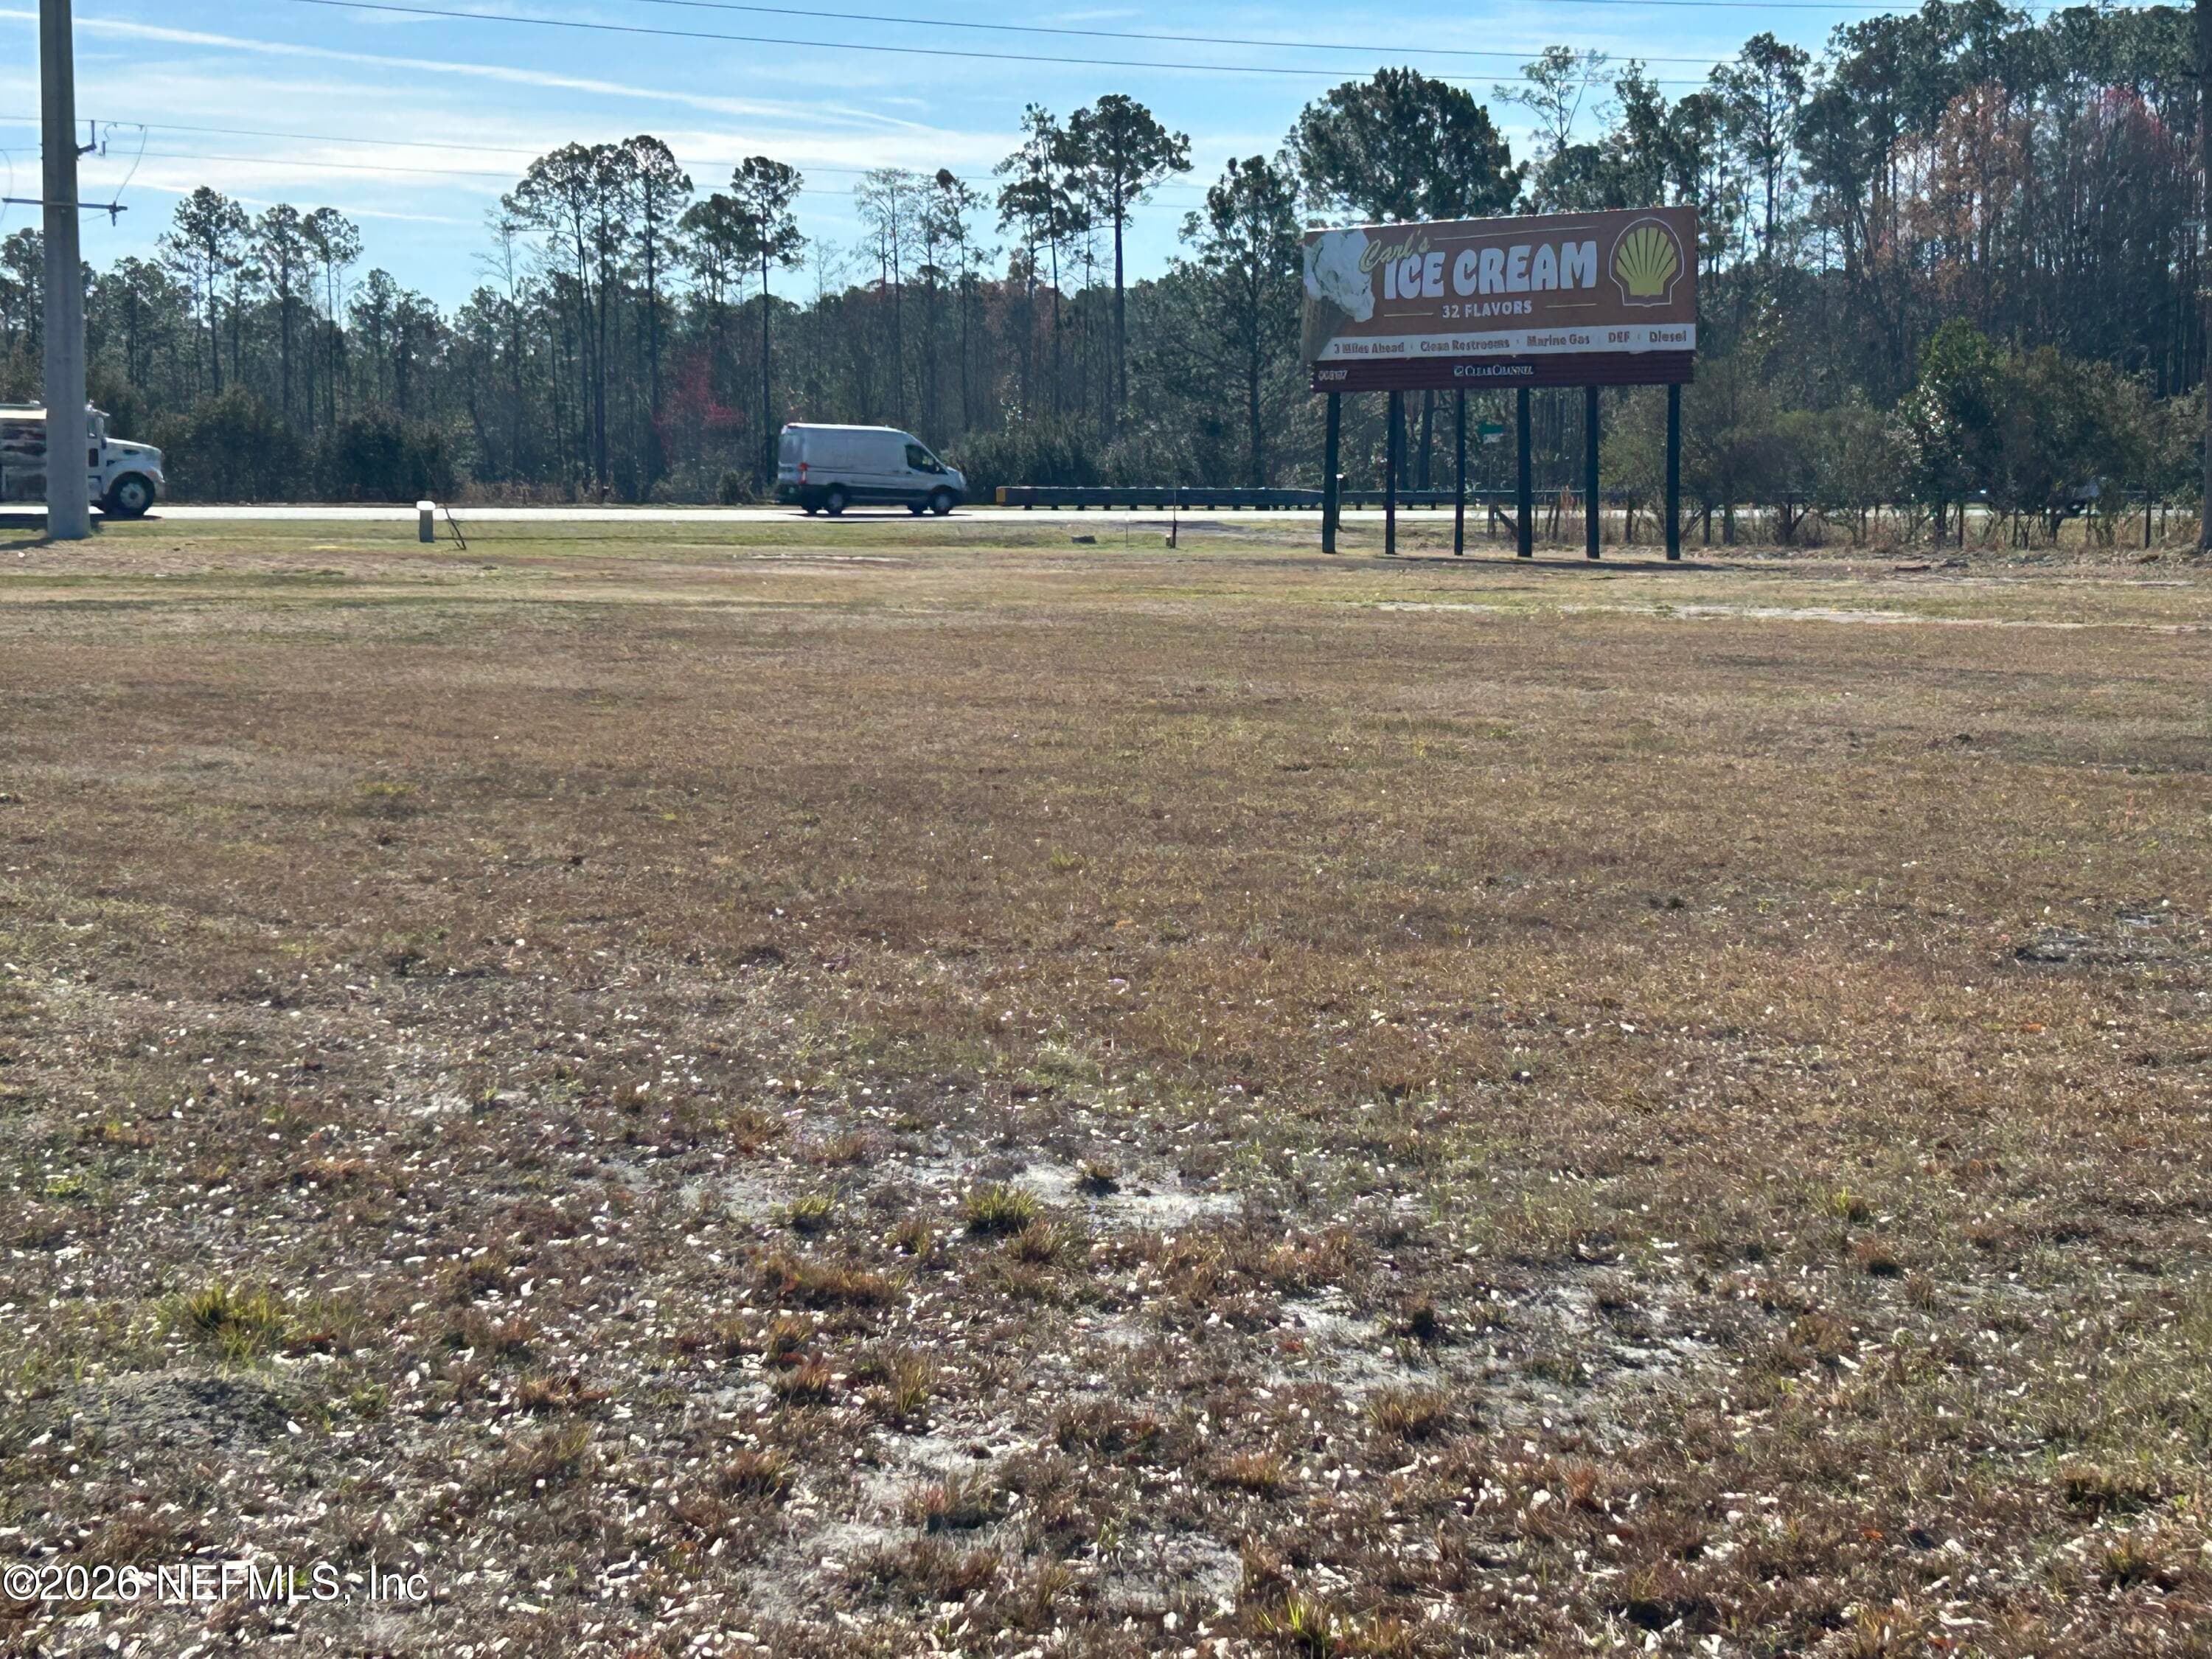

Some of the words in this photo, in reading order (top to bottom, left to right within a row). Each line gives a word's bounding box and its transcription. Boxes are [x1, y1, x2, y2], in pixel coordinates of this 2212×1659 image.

[1359, 229, 1430, 273] Carl's
[1384, 251, 1446, 299] ICE
[1453, 240, 1598, 296] CREAM
[1442, 304, 1460, 319] 32
[1464, 300, 1532, 318] FLAVORS
[1527, 334, 1567, 347] Marine
[1569, 333, 1590, 345] Gas
[1608, 331, 1630, 343] DEF
[1649, 330, 1687, 342] Diesel
[1342, 343, 1369, 354] Miles
[1371, 341, 1405, 354] Ahead
[1420, 340, 1450, 352] Clean
[1452, 338, 1510, 351] Restrooms
